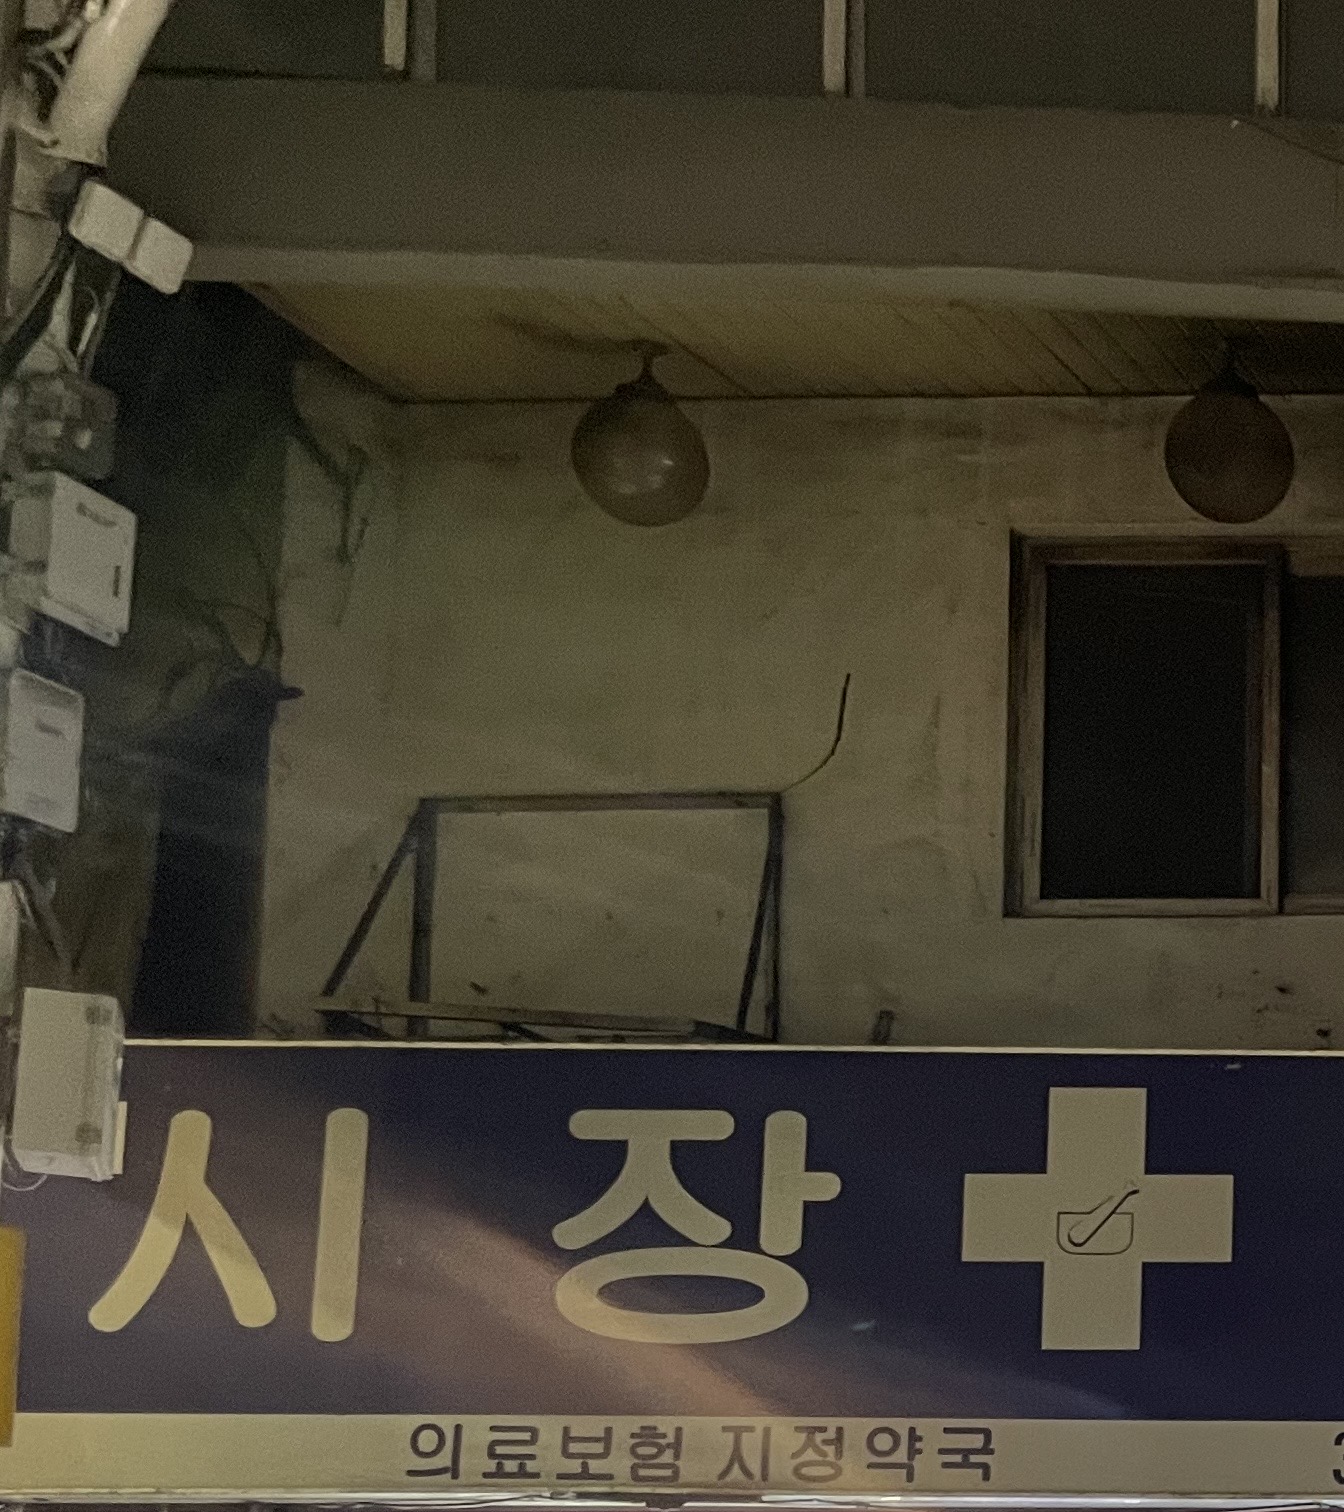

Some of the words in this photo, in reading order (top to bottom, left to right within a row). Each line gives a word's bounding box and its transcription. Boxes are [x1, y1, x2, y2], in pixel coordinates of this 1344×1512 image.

[88, 1107, 841, 1344] 시장
[404, 1422, 686, 1484] 의료보험
[716, 1420, 998, 1486] 지정약국
